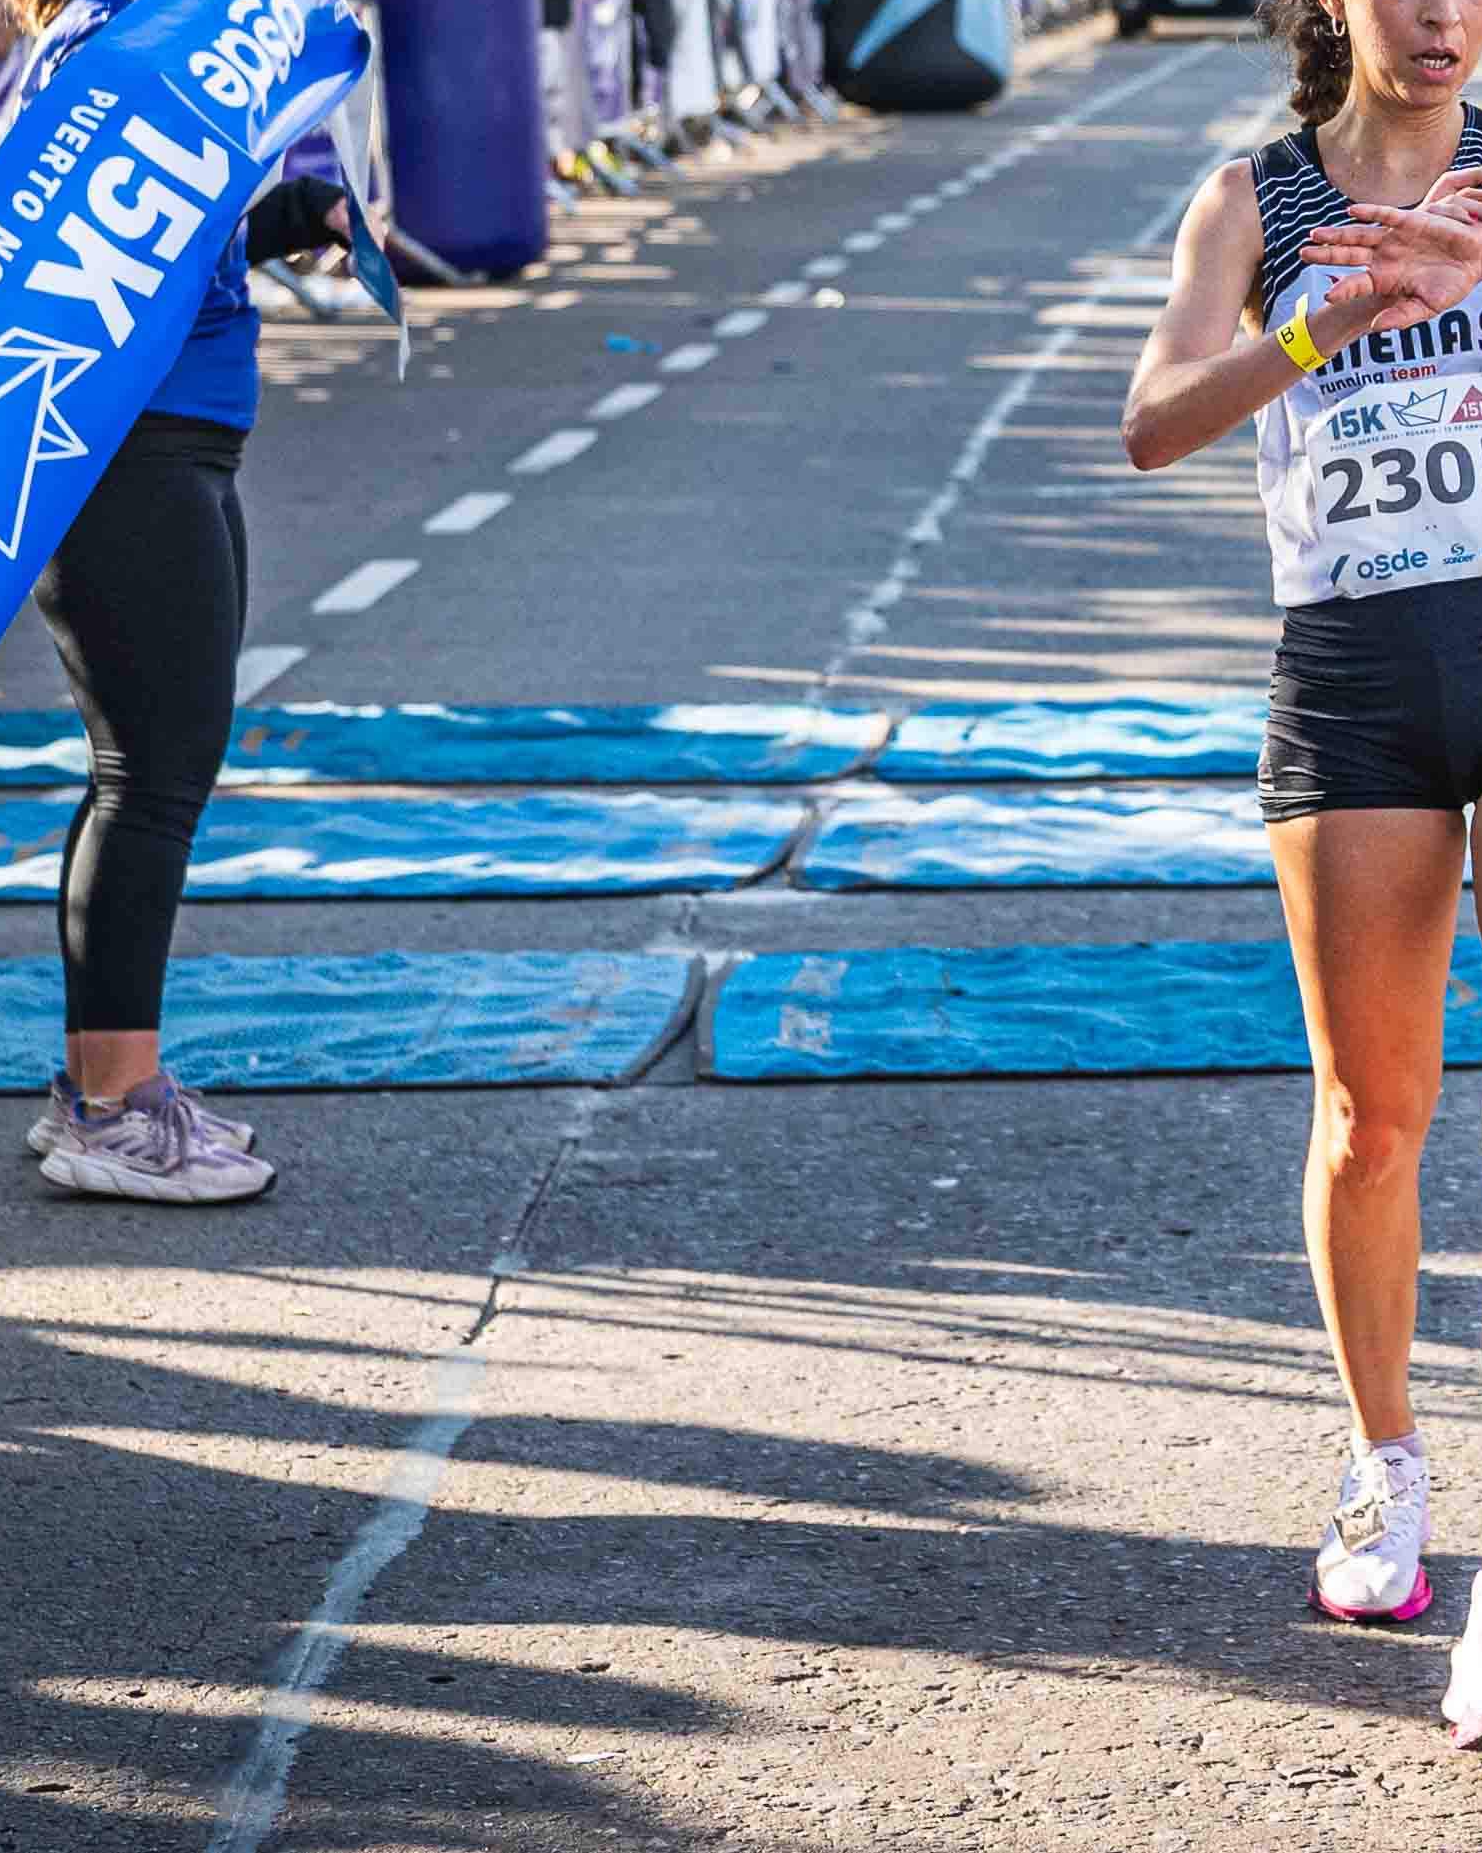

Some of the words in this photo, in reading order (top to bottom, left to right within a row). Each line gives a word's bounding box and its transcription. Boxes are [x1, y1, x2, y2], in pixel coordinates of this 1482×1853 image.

[11, 87, 120, 217] PUERTO
[23, 113, 231, 348] 15K
[1390, 363, 1437, 382] team
[1326, 403, 1386, 441] 15K
[1356, 548, 1429, 580] osde
